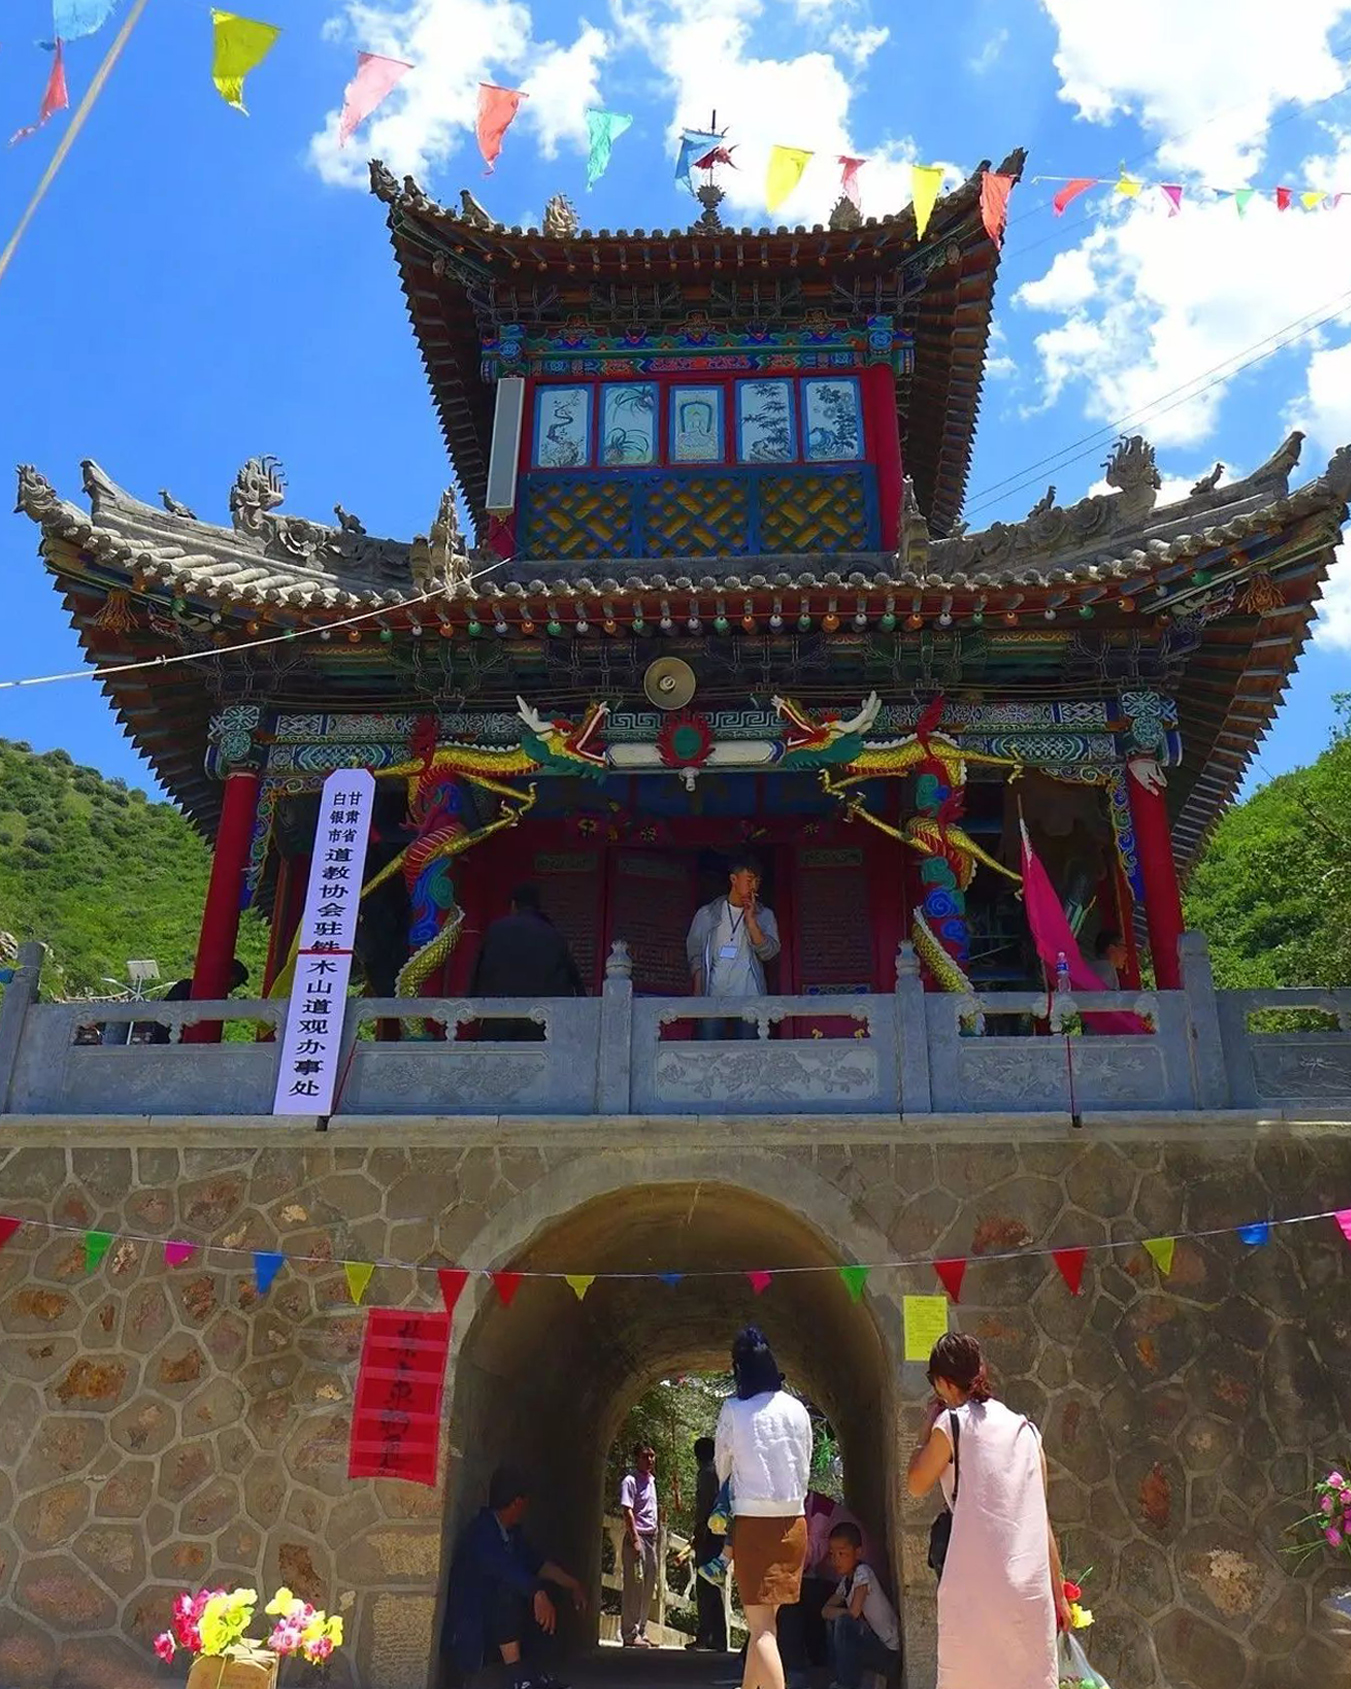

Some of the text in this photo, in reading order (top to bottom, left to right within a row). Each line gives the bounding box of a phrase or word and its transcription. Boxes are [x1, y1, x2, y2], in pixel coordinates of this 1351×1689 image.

[328, 791, 347, 843] 白银市
[341, 791, 363, 843] 甘肃省
